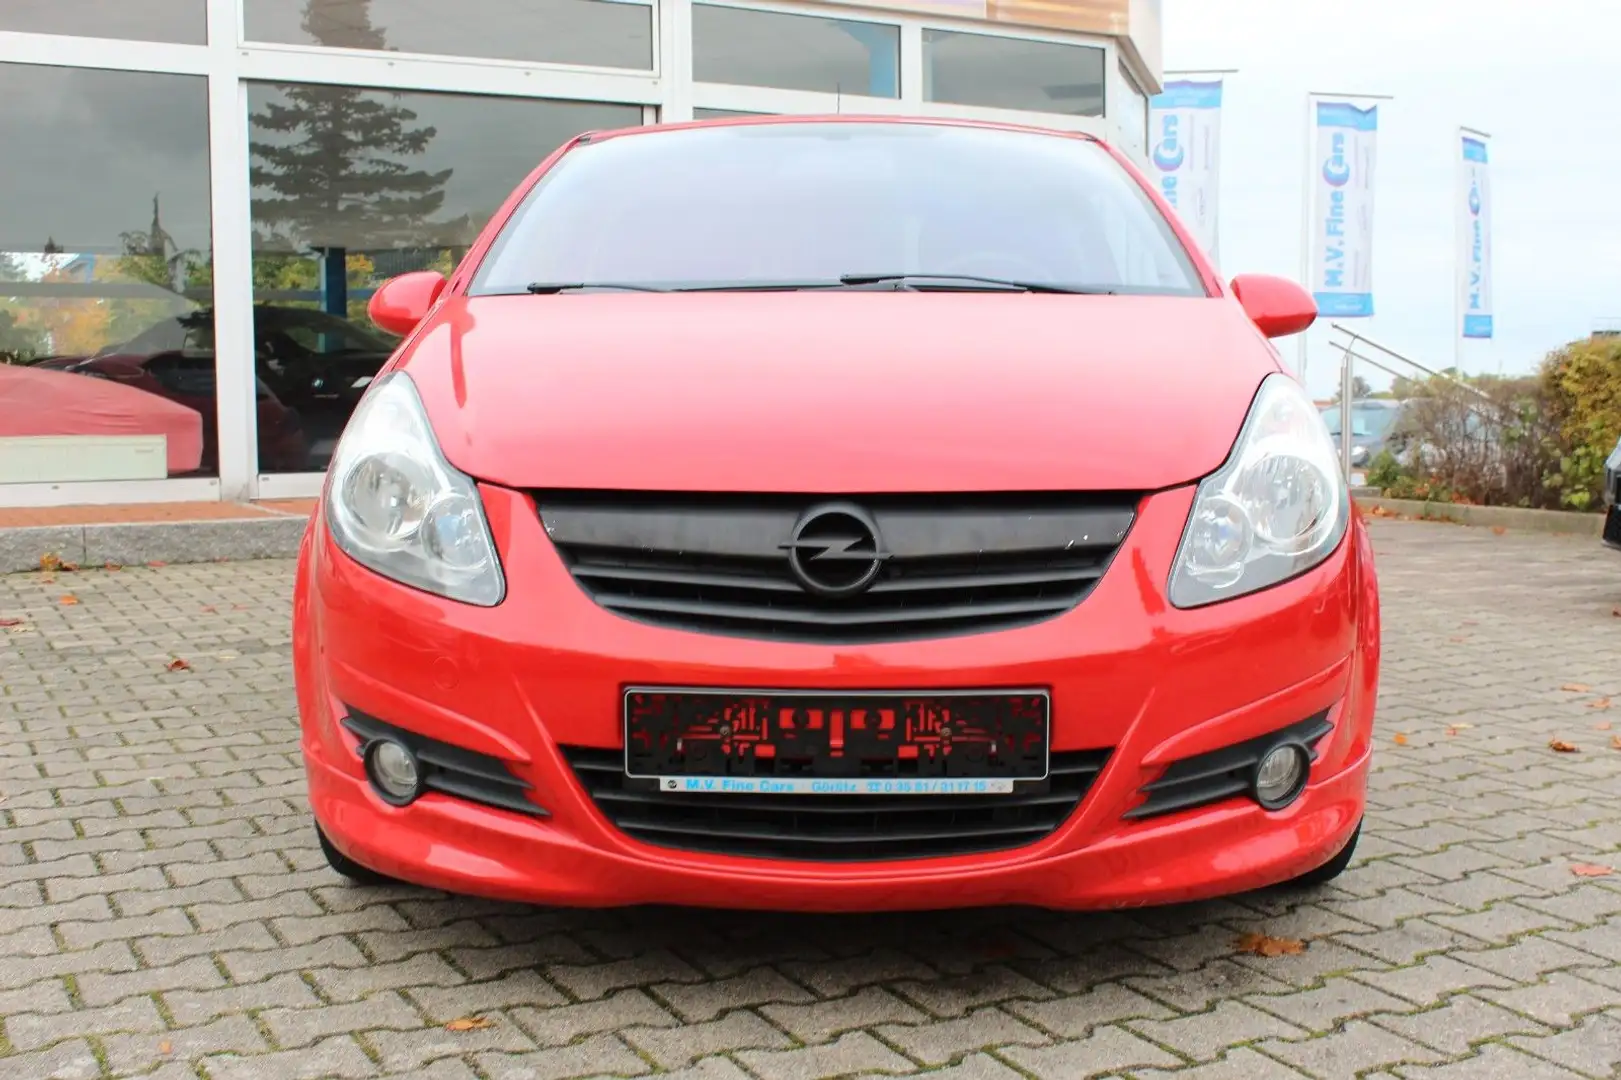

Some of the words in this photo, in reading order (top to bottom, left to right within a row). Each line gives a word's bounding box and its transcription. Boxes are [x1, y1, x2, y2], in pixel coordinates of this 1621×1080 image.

[1153, 114, 1184, 172] Cars
[1322, 132, 1350, 187] Cars
[1325, 190, 1344, 237] Fine
[722, 779, 754, 791] Fine
[759, 780, 794, 792] Cars
